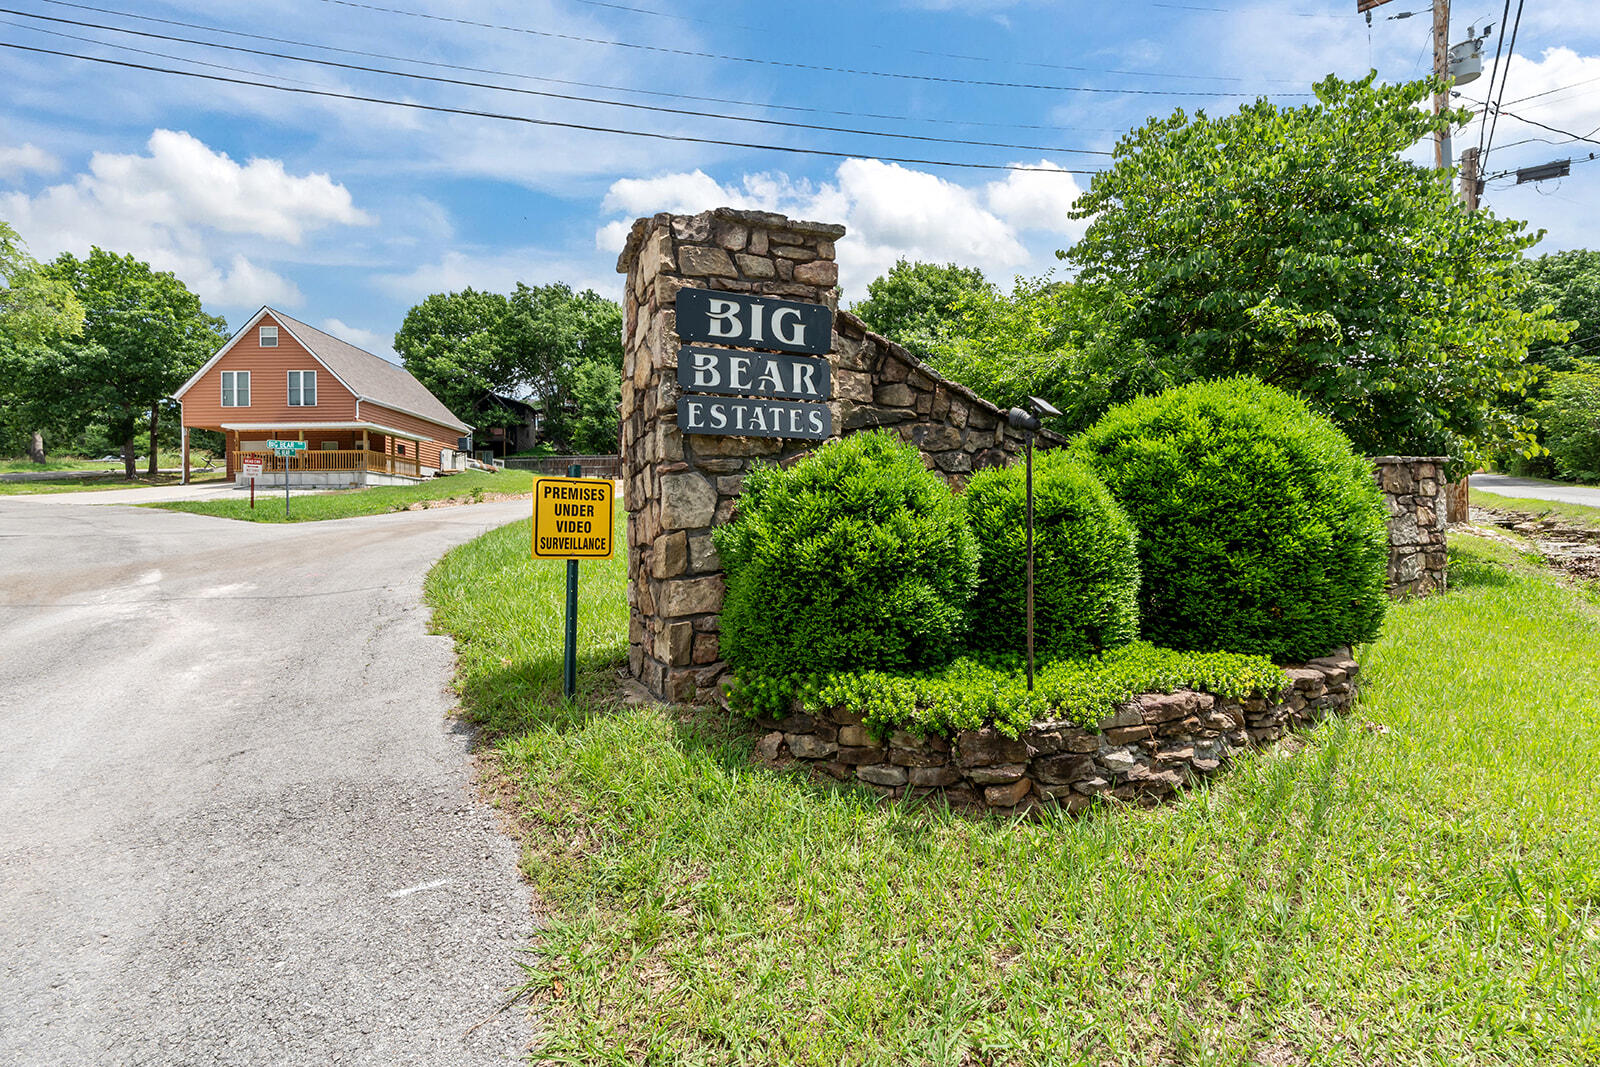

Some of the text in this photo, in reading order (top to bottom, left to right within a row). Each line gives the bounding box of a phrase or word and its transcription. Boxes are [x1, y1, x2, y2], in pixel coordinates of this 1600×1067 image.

[705, 298, 807, 346] BIG
[691, 353, 818, 395] BEAR
[687, 402, 824, 434] ESTATES
[543, 486, 605, 501] PREMISES
[554, 503, 594, 517] UNDER
[556, 520, 591, 533] VIDEO
[540, 536, 606, 550] SURVEILLANCE
